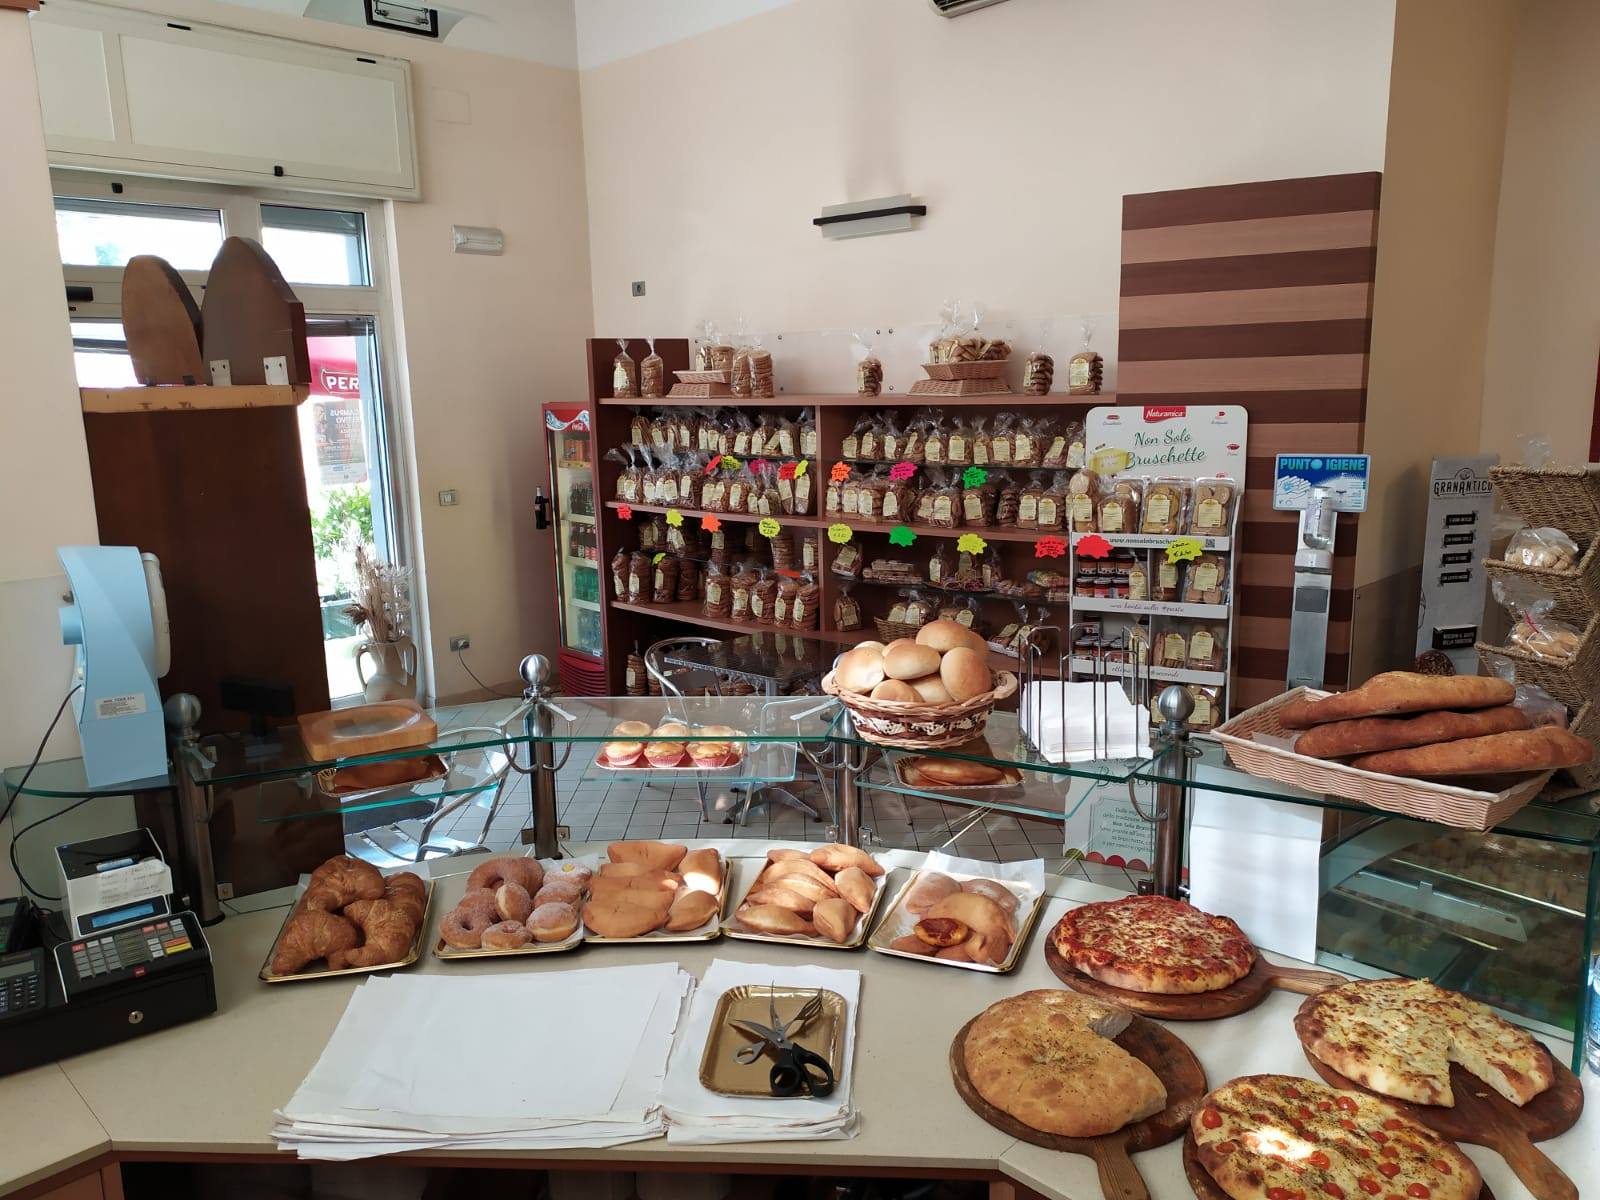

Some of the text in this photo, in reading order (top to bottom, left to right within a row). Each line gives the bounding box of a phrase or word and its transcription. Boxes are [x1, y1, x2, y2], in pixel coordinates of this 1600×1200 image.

[326, 376, 359, 390] PER
[1145, 408, 1185, 418] Naturamica
[1134, 428, 1192, 447] Non Solo
[1125, 446, 1206, 470] Bruschette
[1280, 458, 1366, 470] PUNTO IGIENE
